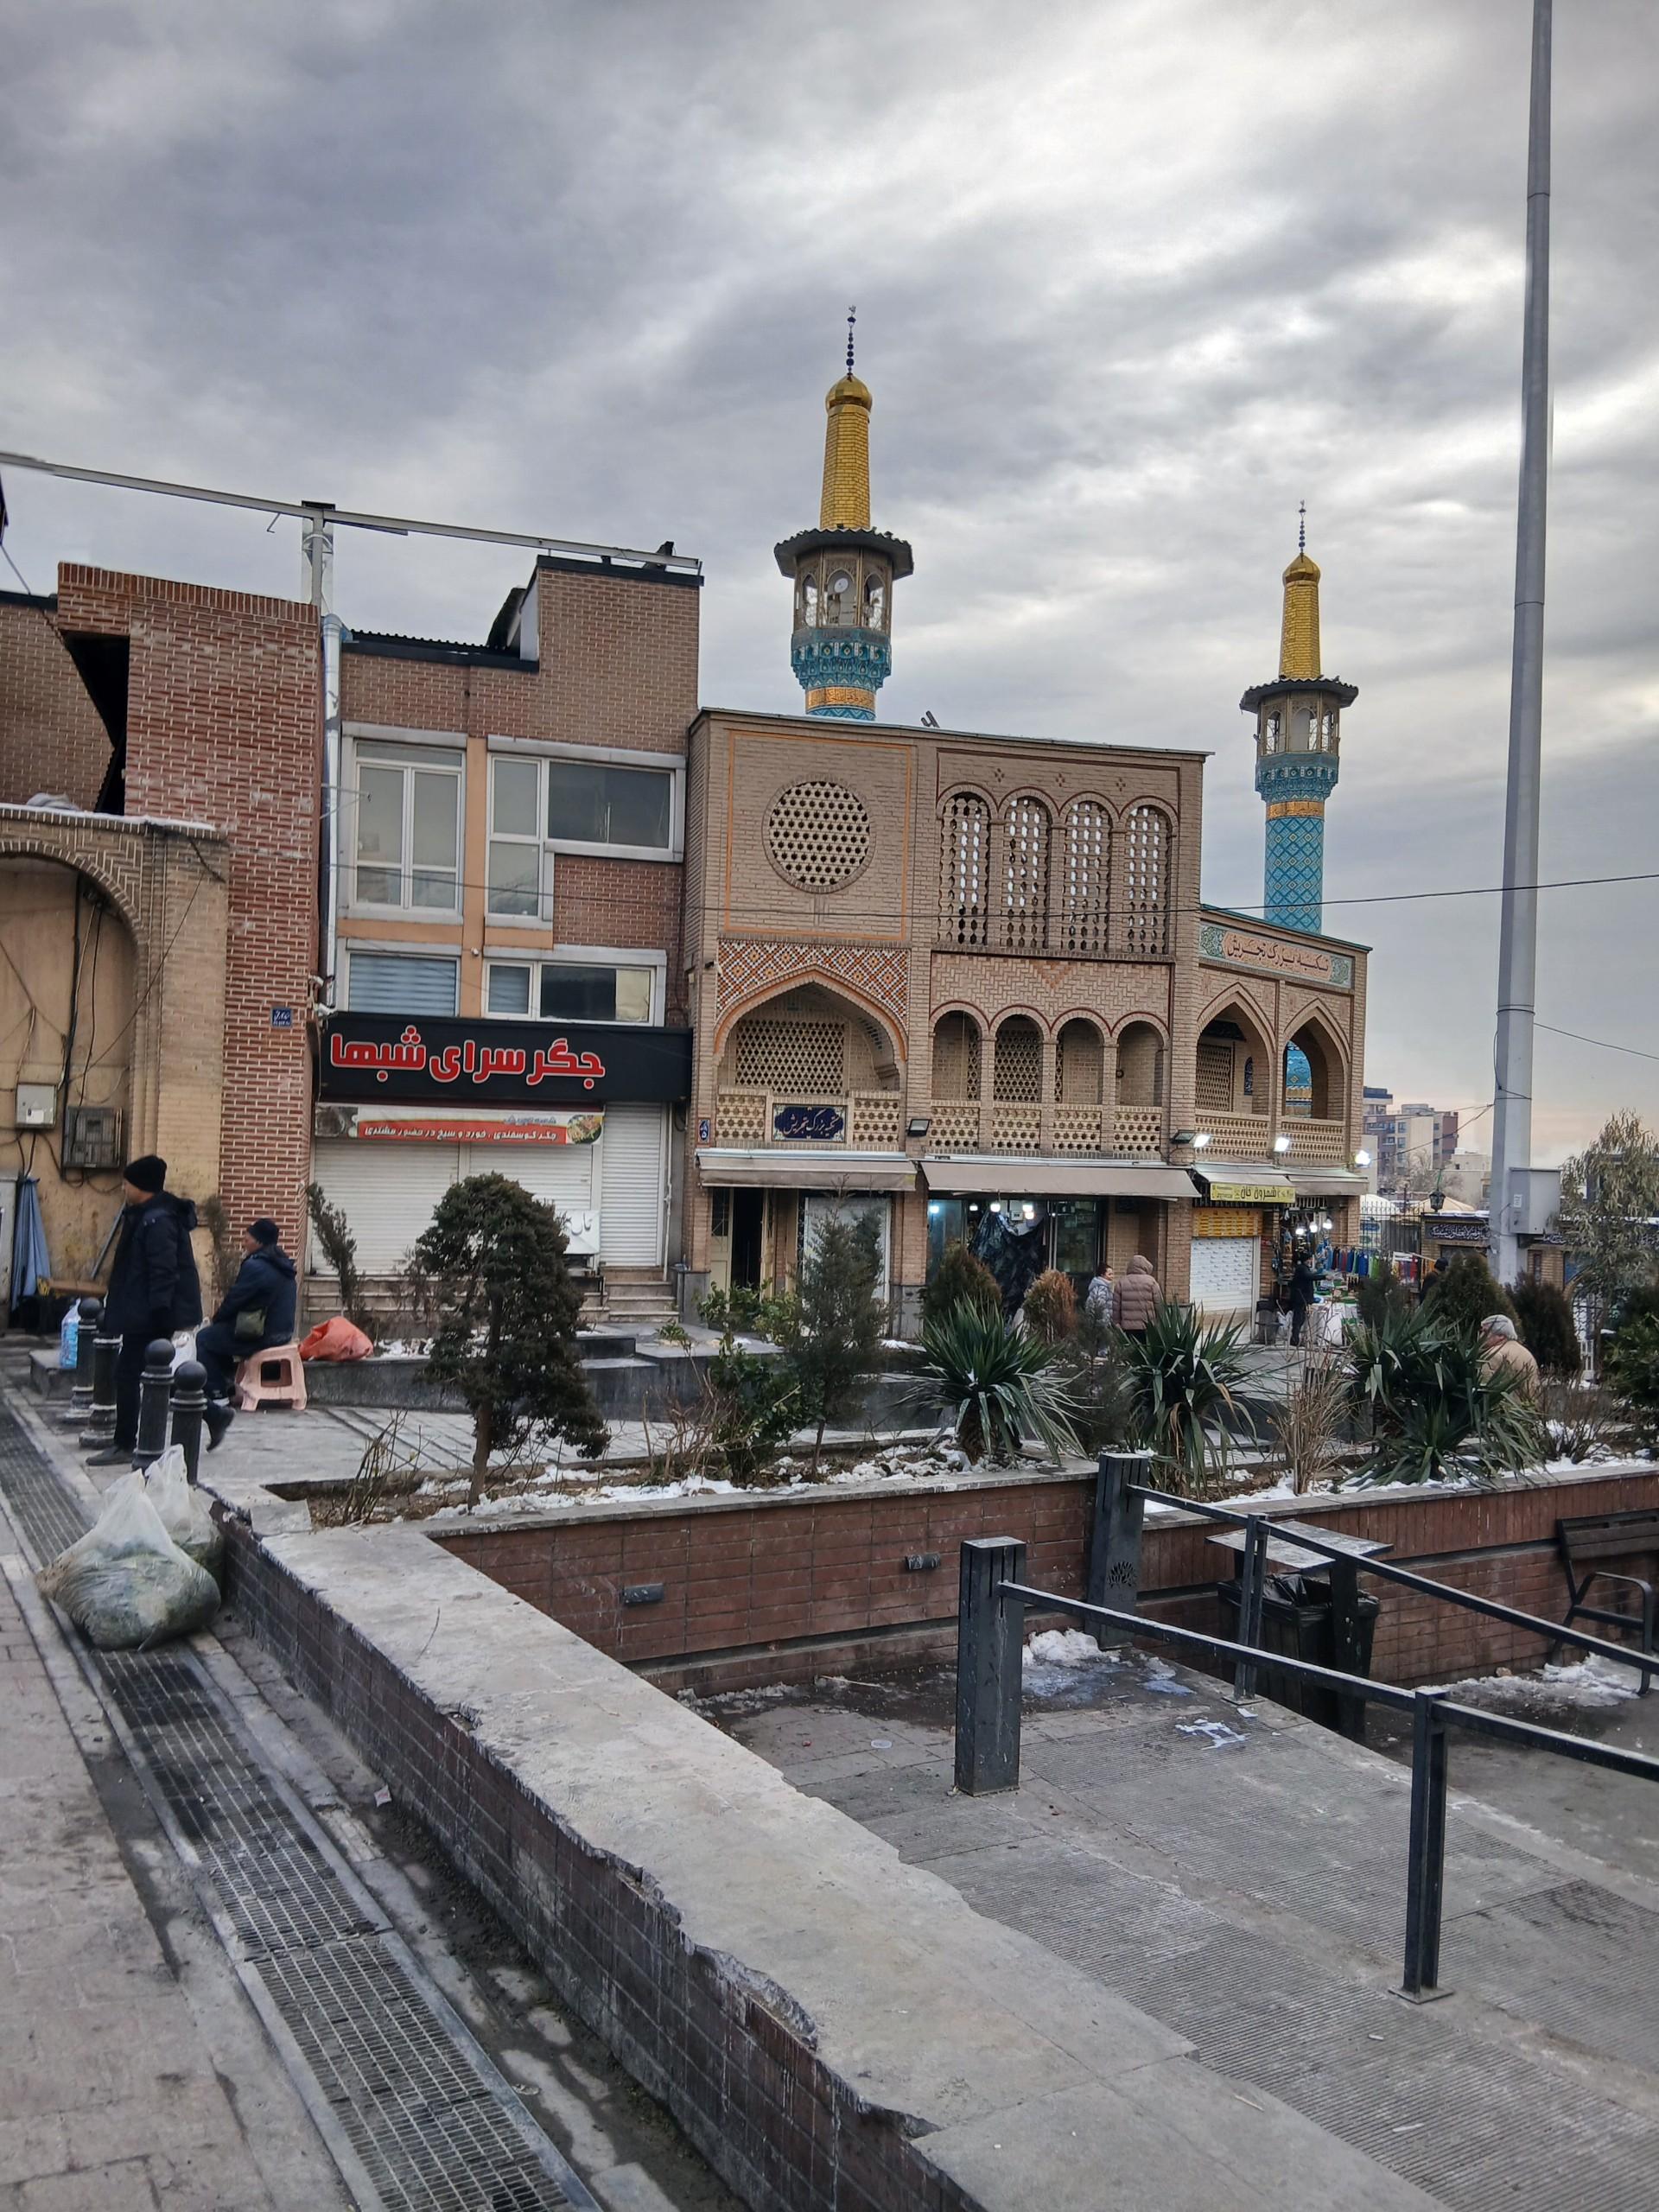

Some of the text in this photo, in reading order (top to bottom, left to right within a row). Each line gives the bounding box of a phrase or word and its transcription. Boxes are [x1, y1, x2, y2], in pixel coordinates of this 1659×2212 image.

[1227, 935, 1266, 961] تجریش
[1267, 944, 1296, 967] بزرگ
[330, 1026, 606, 1090] جگر سرای شبها
[783, 1108, 840, 1137] تکیه بزرگ تجریش
[364, 1125, 396, 1136] مشتری
[397, 1128, 423, 1137] حضور
[436, 1128, 456, 1140] سیخ
[466, 1128, 486, 1139] خورد
[538, 1130, 556, 1141] جگر
